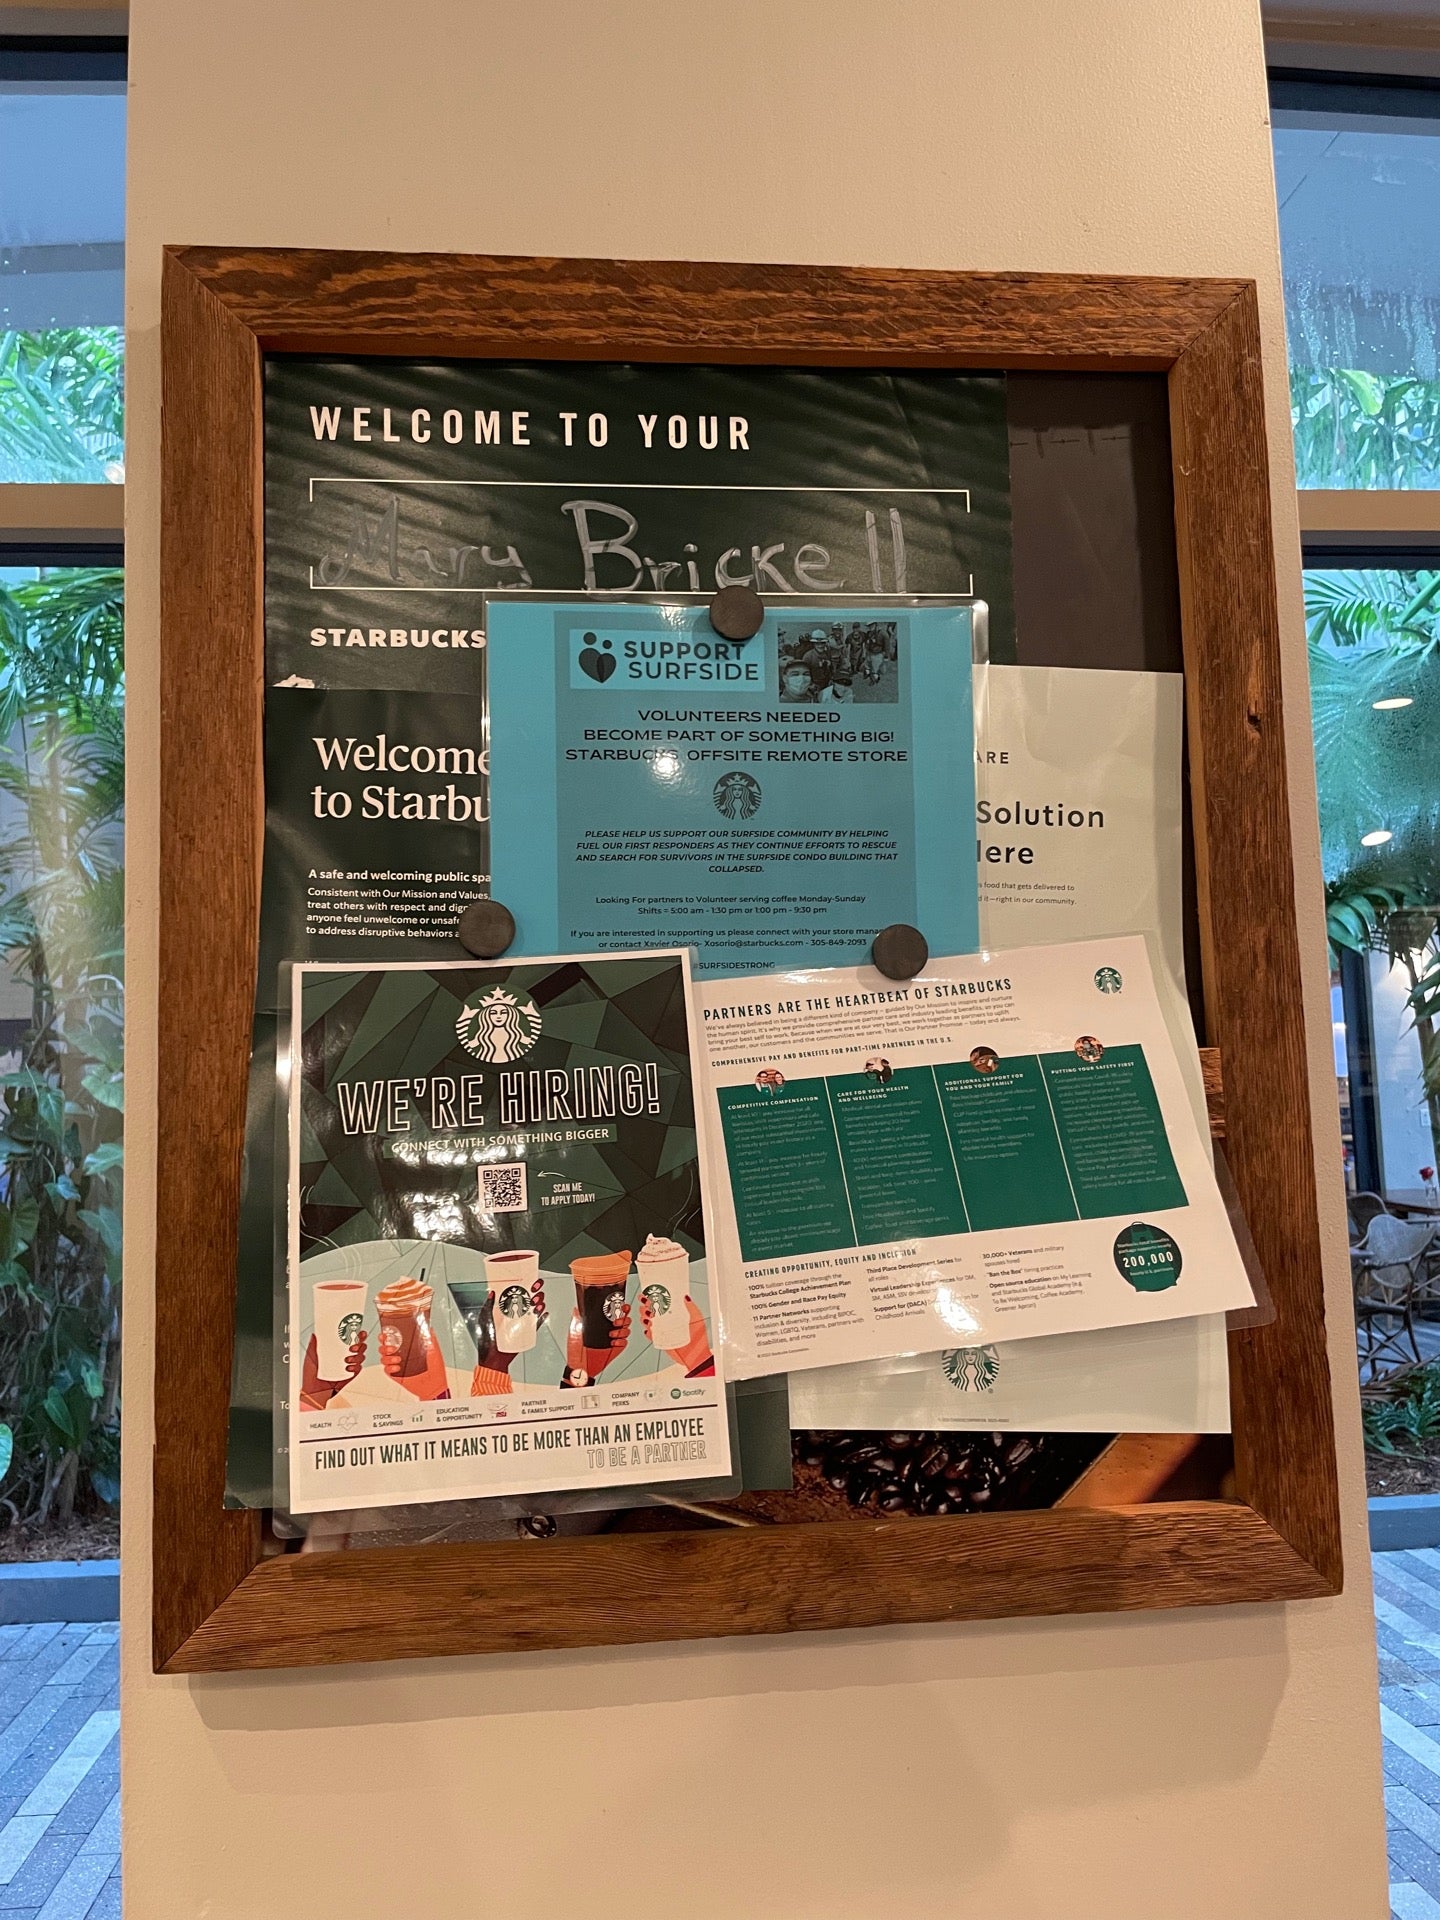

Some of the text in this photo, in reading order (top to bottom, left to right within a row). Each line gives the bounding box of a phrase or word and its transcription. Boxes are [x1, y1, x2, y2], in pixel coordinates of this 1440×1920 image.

[309, 407, 749, 449] WELCOME TO YOUR
[309, 627, 487, 649] STARBUCKS
[623, 641, 746, 660] SUPPORT
[628, 661, 759, 680] SURFSIDE
[637, 710, 840, 722] VOLUNTEERS NEEDED
[583, 729, 893, 742] BECOME PART OF SOMETHING BIG!
[687, 750, 762, 761] OFFSITE
[767, 750, 843, 761] REMOTE
[847, 750, 907, 761] STORE
[310, 785, 352, 819] to
[976, 801, 1103, 827] Solution
[652, 841, 714, 849] RESPONDERS
[715, 841, 728, 849] AS
[730, 841, 755, 849] THEY
[755, 841, 803, 849] CONTINUE
[804, 841, 845, 849] EFFORTS
[847, 841, 859, 849] TO
[638, 853, 658, 861] FOR
[659, 853, 712, 861] SURVIVORS
[308, 868, 317, 878] A
[319, 869, 344, 879] safe
[345, 870, 368, 879] and
[369, 870, 432, 882] welcoming
[434, 871, 469, 882] public
[307, 887, 358, 897] Consistent
[359, 889, 381, 897] with
[382, 889, 400, 897] Our
[401, 889, 437, 898] Mission
[438, 890, 457, 899] and
[595, 896, 630, 905] Looking
[695, 895, 737, 903] Volunteer
[738, 895, 769, 904] serving
[798, 895, 865, 903] Monday-Sunday
[306, 901, 446, 912] treat others with respect and
[570, 929, 576, 937] If
[657, 928, 665, 936] in
[666, 929, 713, 937] supporting
[727, 928, 754, 936] please
[609, 941, 641, 949] contact
[811, 938, 867, 946] 305-849-2093
[703, 978, 1011, 1020] PARTNERS ARE THE HEARTBEAT OF STARBUCKS
[500, 1062, 661, 1125] HIRING!
[391, 1128, 609, 1154] CONNECT WITH SOMETHING BIGGER
[552, 1182, 582, 1193] SCAN ME
[540, 1193, 595, 1205] TO APPLY TODAY!
[744, 1253, 876, 1278] CREATING OPPORTUNITY, EQUITY AND
[1122, 1251, 1174, 1268] 200,000
[315, 1418, 704, 1469] FIND OUT WHAT IT MEANS TO BE MORE THAN AN EMPLOYEE
[586, 1440, 707, 1468] TO BE A PARTNER
